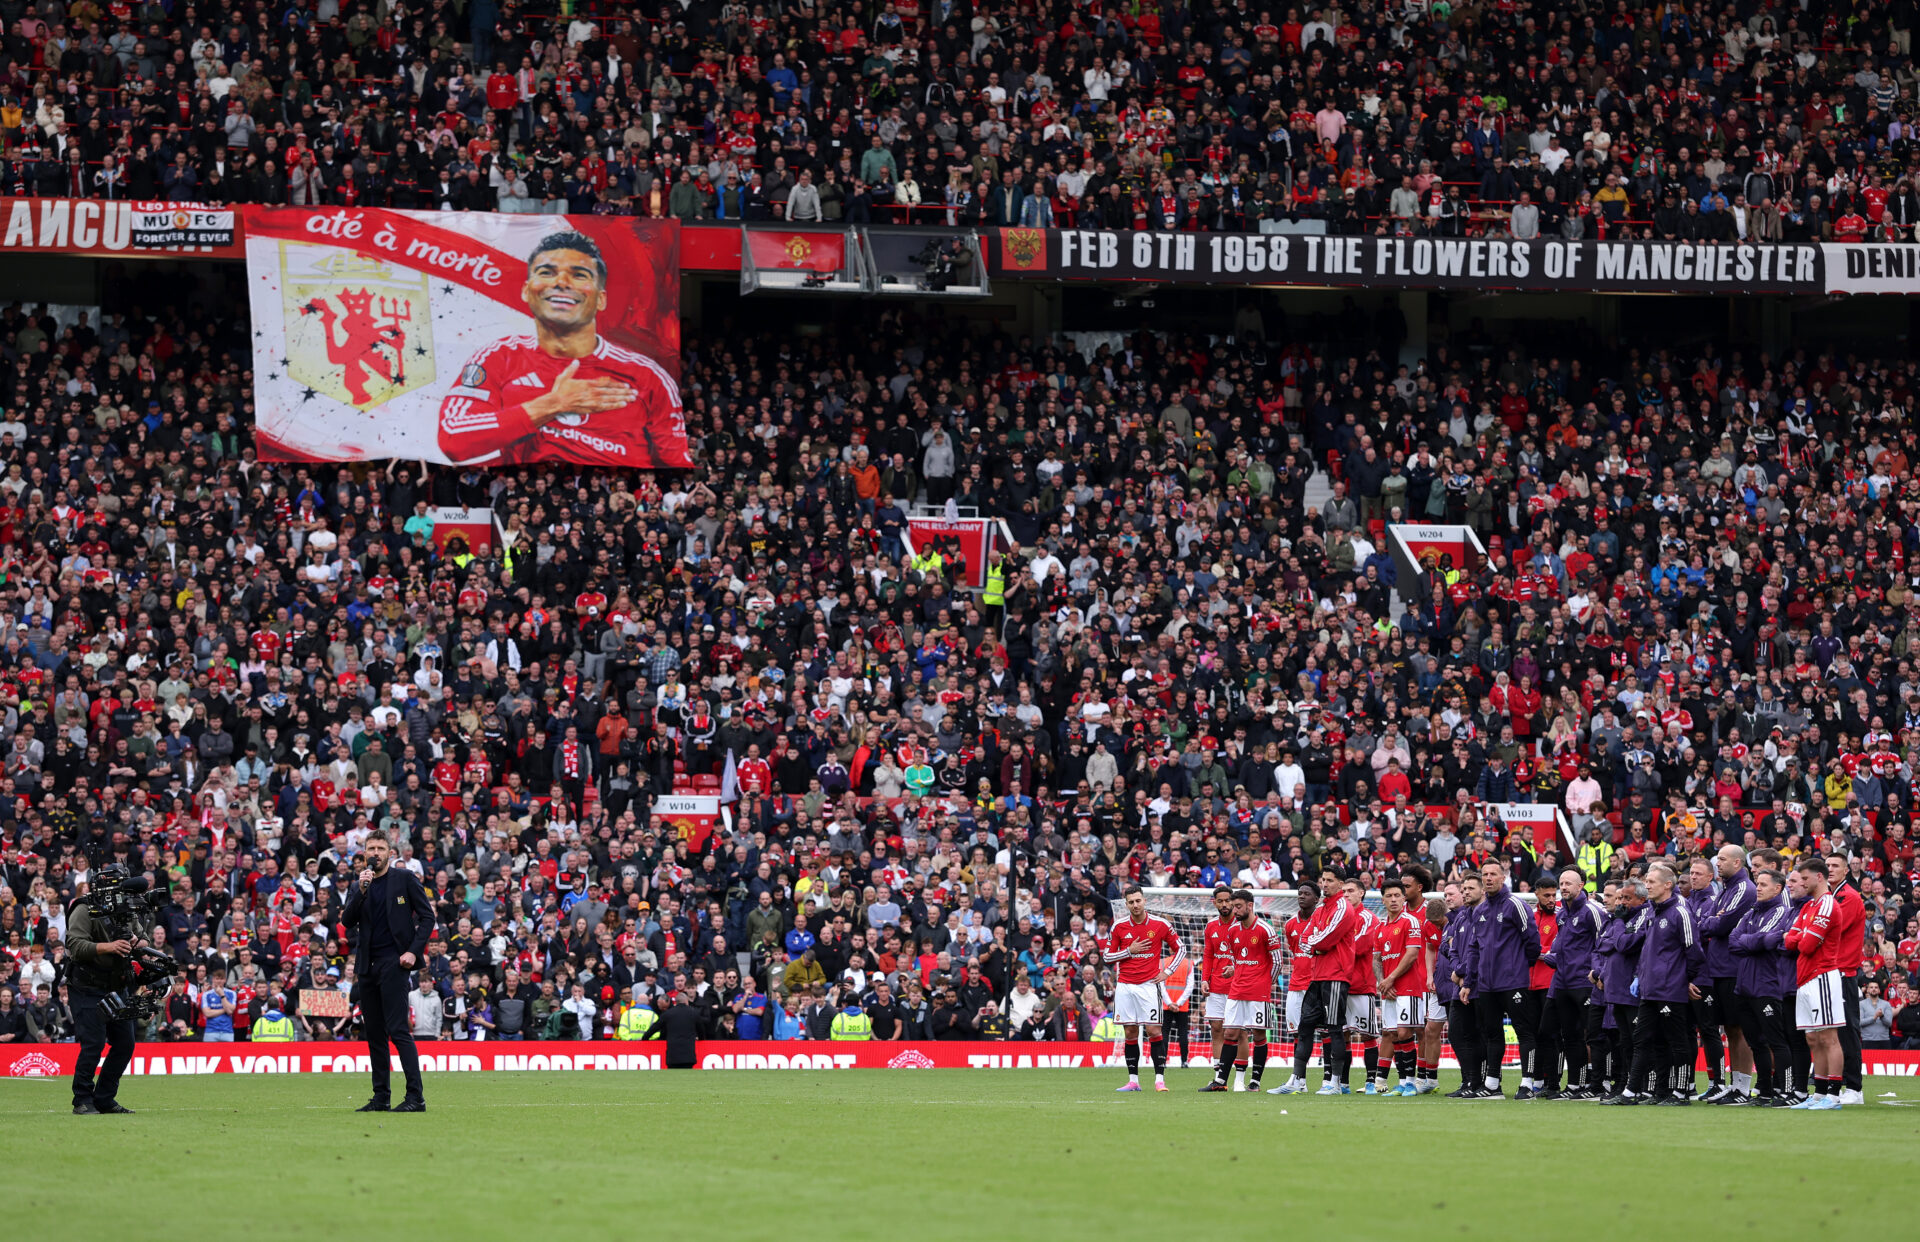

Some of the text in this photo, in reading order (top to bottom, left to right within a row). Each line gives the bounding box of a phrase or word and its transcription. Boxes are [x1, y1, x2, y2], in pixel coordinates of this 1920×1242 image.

[143, 215, 169, 227] MU
[195, 215, 216, 226] FC
[135, 232, 230, 243] FOREVER & EVER
[305, 210, 502, 286] até à morte
[1061, 231, 1816, 282] FEB 6TH 1958 THE FLOWERS OF MANCHESTER
[1846, 248, 1920, 279] DENI
[443, 512, 470, 520] W206
[912, 522, 930, 530] THE
[952, 523, 981, 532] ARMY
[1419, 530, 1443, 538] W204
[669, 802, 697, 810] W104
[1507, 810, 1533, 818] W103
[1150, 1009, 1158, 1021] 2
[1256, 1012, 1263, 1024] 8
[1400, 1008, 1409, 1021] 6
[1812, 1009, 1819, 1023] 7
